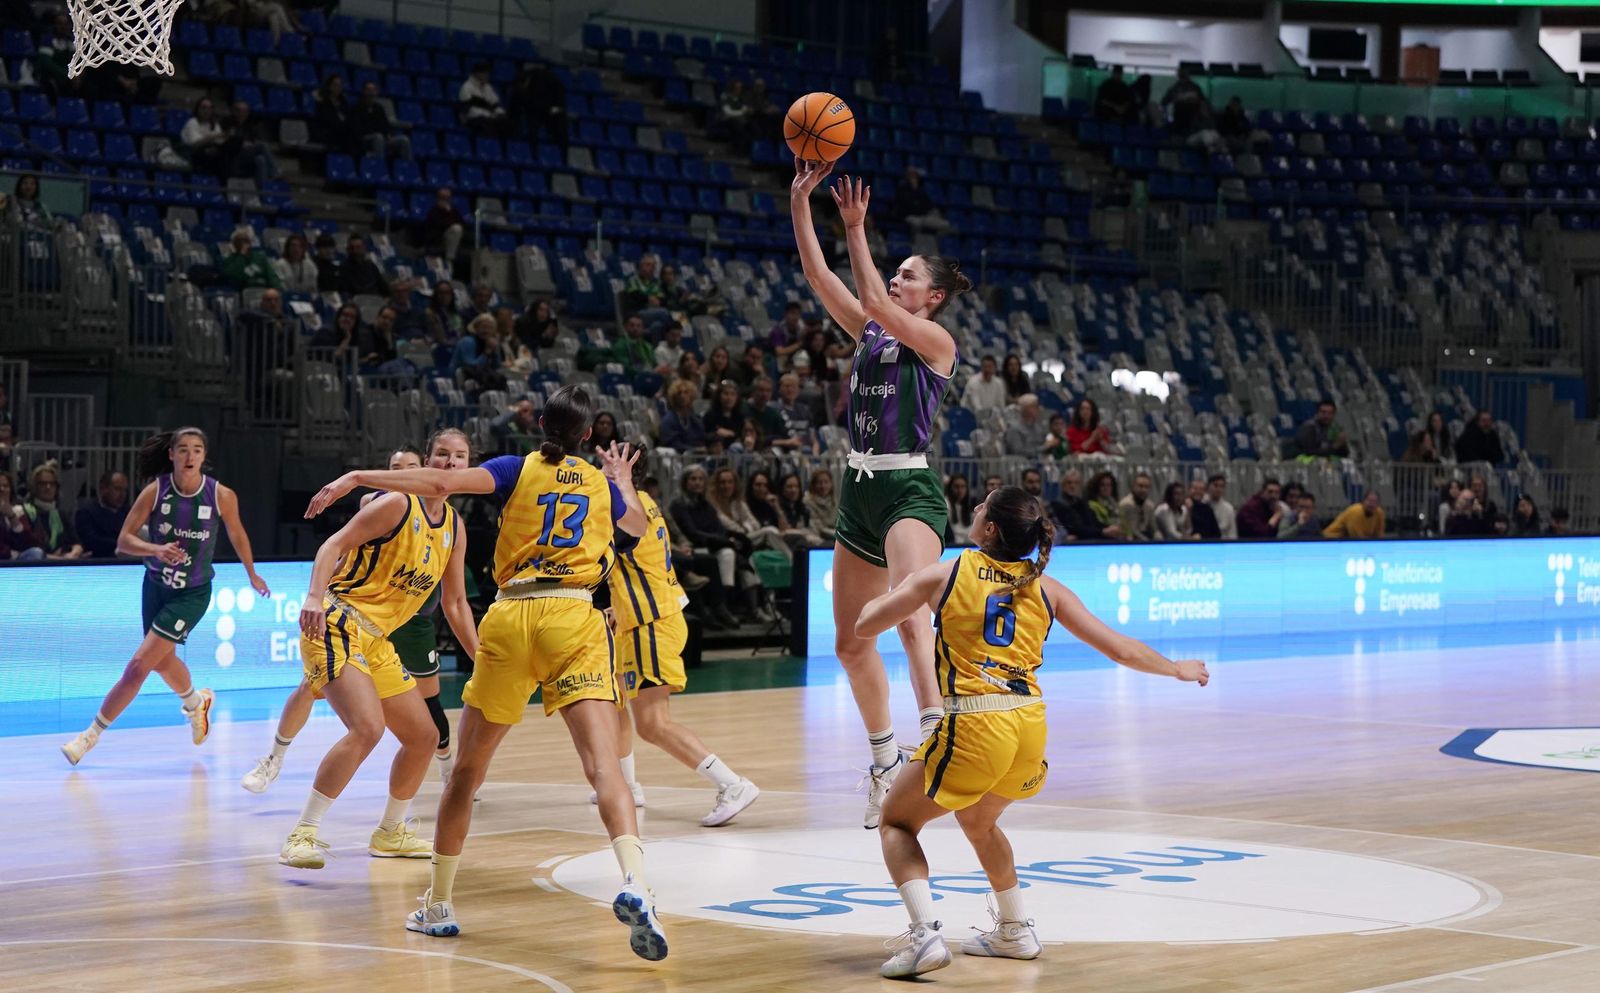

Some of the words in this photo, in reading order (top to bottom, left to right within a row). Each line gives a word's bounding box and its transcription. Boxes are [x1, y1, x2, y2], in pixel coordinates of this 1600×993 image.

[556, 468, 584, 486] GURI
[536, 492, 590, 548] 13
[174, 528, 210, 541] Unicaja
[162, 567, 187, 589] 55
[1149, 566, 1222, 590] Telefónica
[1380, 561, 1443, 584] Telefónica
[1149, 597, 1219, 624] Empresas
[1380, 589, 1440, 616] Empresas
[983, 593, 1016, 647] 6
[556, 672, 604, 691] MELILLA
